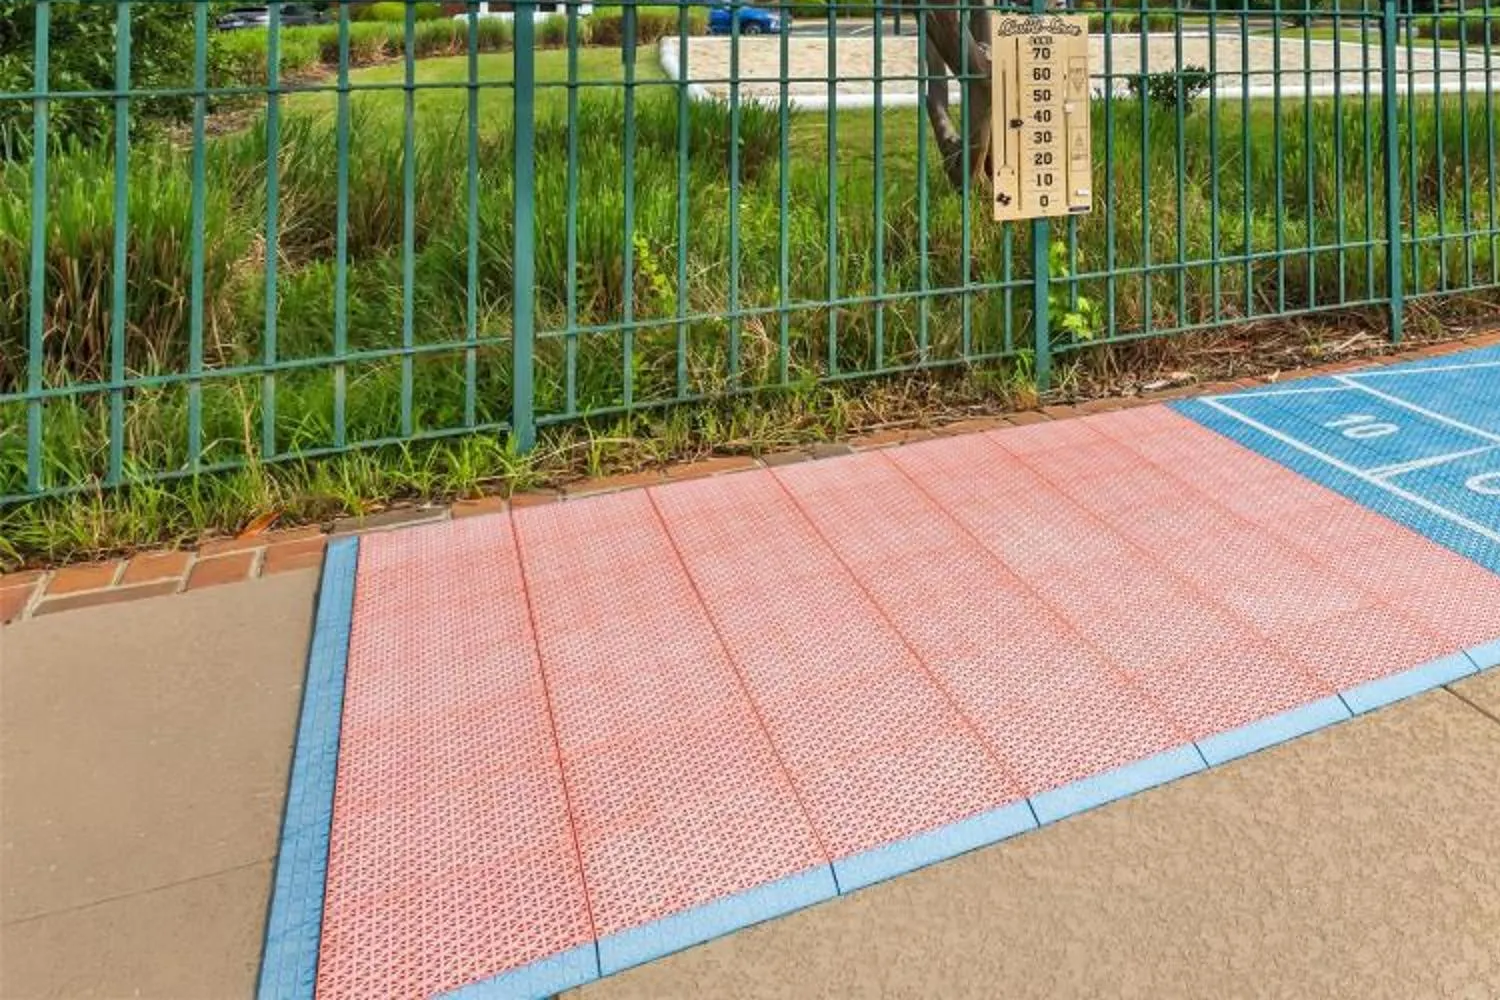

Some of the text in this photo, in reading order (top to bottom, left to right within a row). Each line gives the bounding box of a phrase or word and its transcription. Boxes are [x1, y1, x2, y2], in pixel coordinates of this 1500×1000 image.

[1032, 47, 1050, 59] 70
[1033, 68, 1051, 81] 60
[1033, 89, 1051, 102] 50
[1033, 110, 1051, 122] 40
[1034, 131, 1052, 144] 30
[1034, 152, 1053, 165] 20
[1037, 174, 1053, 187] 10
[1039, 195, 1049, 207] 0
[1324, 414, 1400, 439] 10
